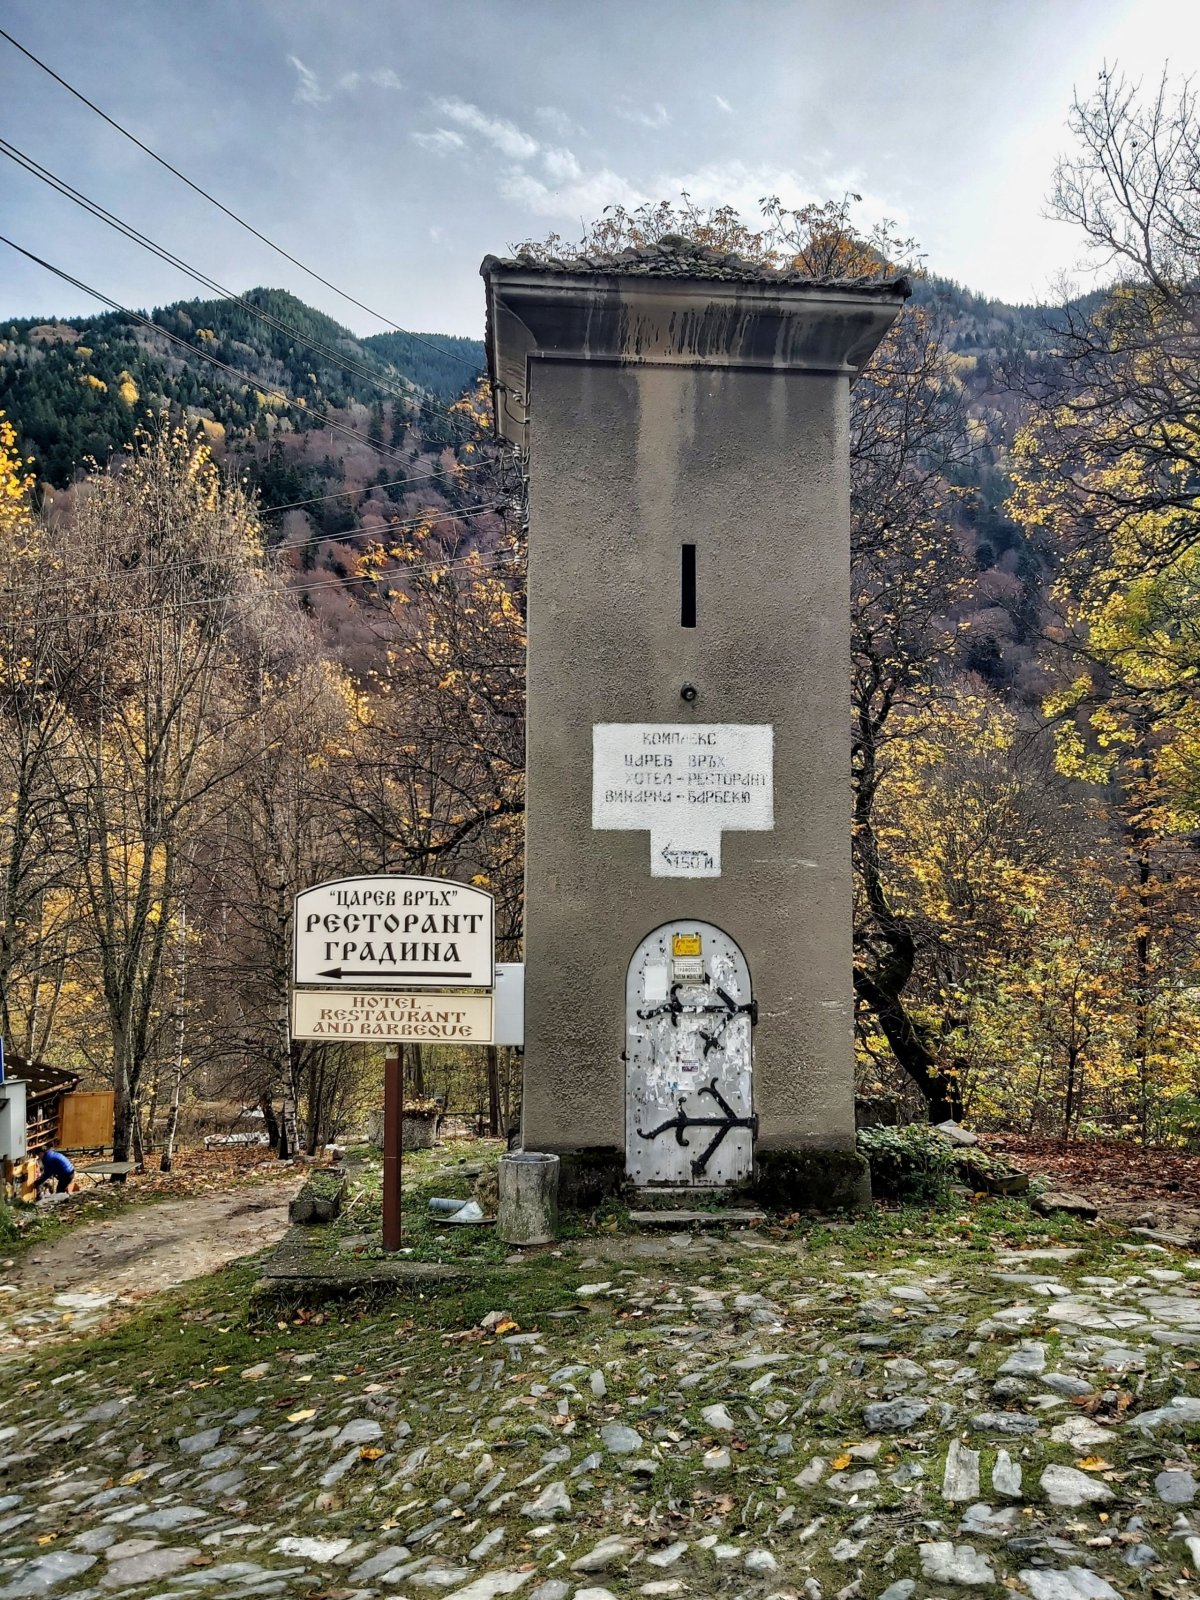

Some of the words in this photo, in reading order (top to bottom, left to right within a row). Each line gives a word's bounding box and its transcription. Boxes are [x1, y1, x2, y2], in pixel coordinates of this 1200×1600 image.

[625, 773, 672, 786] ХОТЕЛ
[688, 773, 767, 786] РЕСТОРАНТ
[605, 790, 672, 803] ВИНАРНА
[687, 790, 751, 803] БАРБЕКЮ
[305, 913, 484, 934] РЕСТОРАНТ
[324, 941, 462, 965] ГРАДИНА
[352, 996, 421, 1009] HOTEL
[320, 1009, 466, 1023] RESTAURANT
[312, 1022, 354, 1034] AND
[360, 1022, 473, 1038] BARBEQUE
